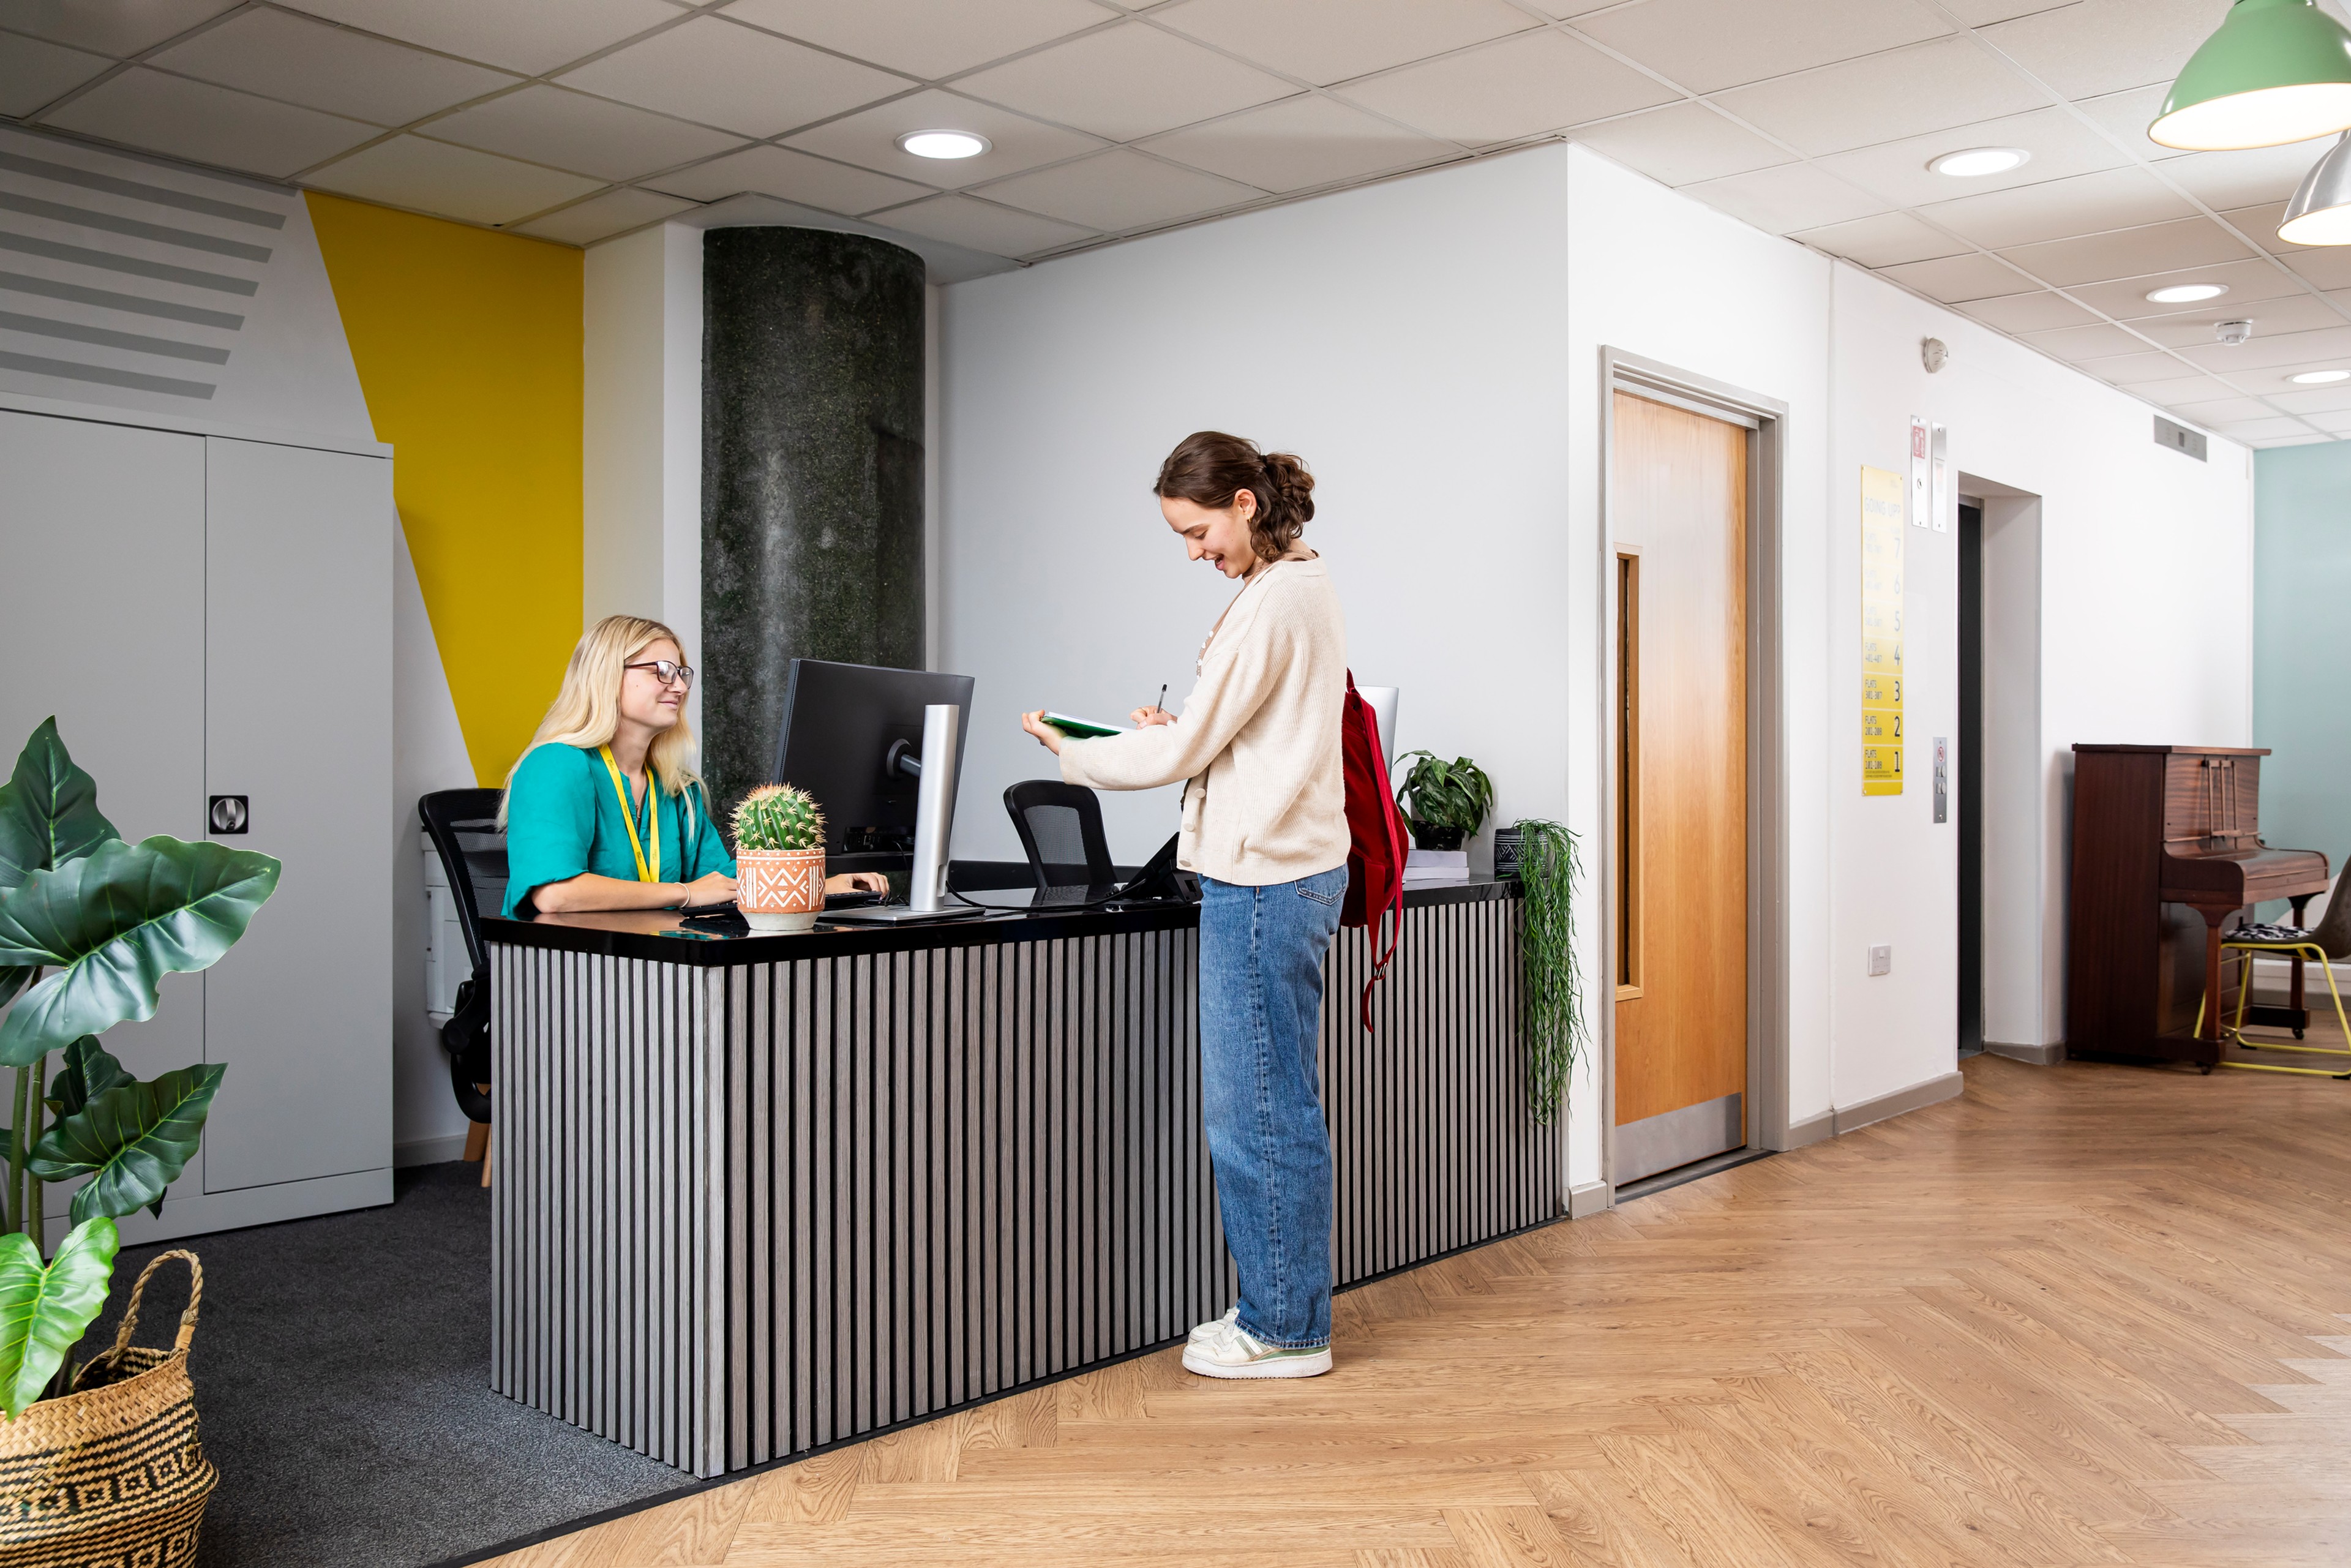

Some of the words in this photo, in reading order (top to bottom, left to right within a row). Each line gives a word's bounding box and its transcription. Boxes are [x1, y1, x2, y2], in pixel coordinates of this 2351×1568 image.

[1864, 497, 1886, 516] GOING
[1888, 503, 1901, 517] UP?
[1894, 537, 1901, 558] 7
[1894, 573, 1901, 595] 6
[1894, 610, 1901, 632] 5
[1894, 645, 1900, 666] 4
[1865, 679, 1877, 689] FLATS
[1894, 680, 1900, 702] 3
[1865, 715, 1877, 724] FLATS
[1894, 716, 1900, 737] 2
[1865, 749, 1877, 759] FLATS
[1894, 751, 1900, 772] 1
